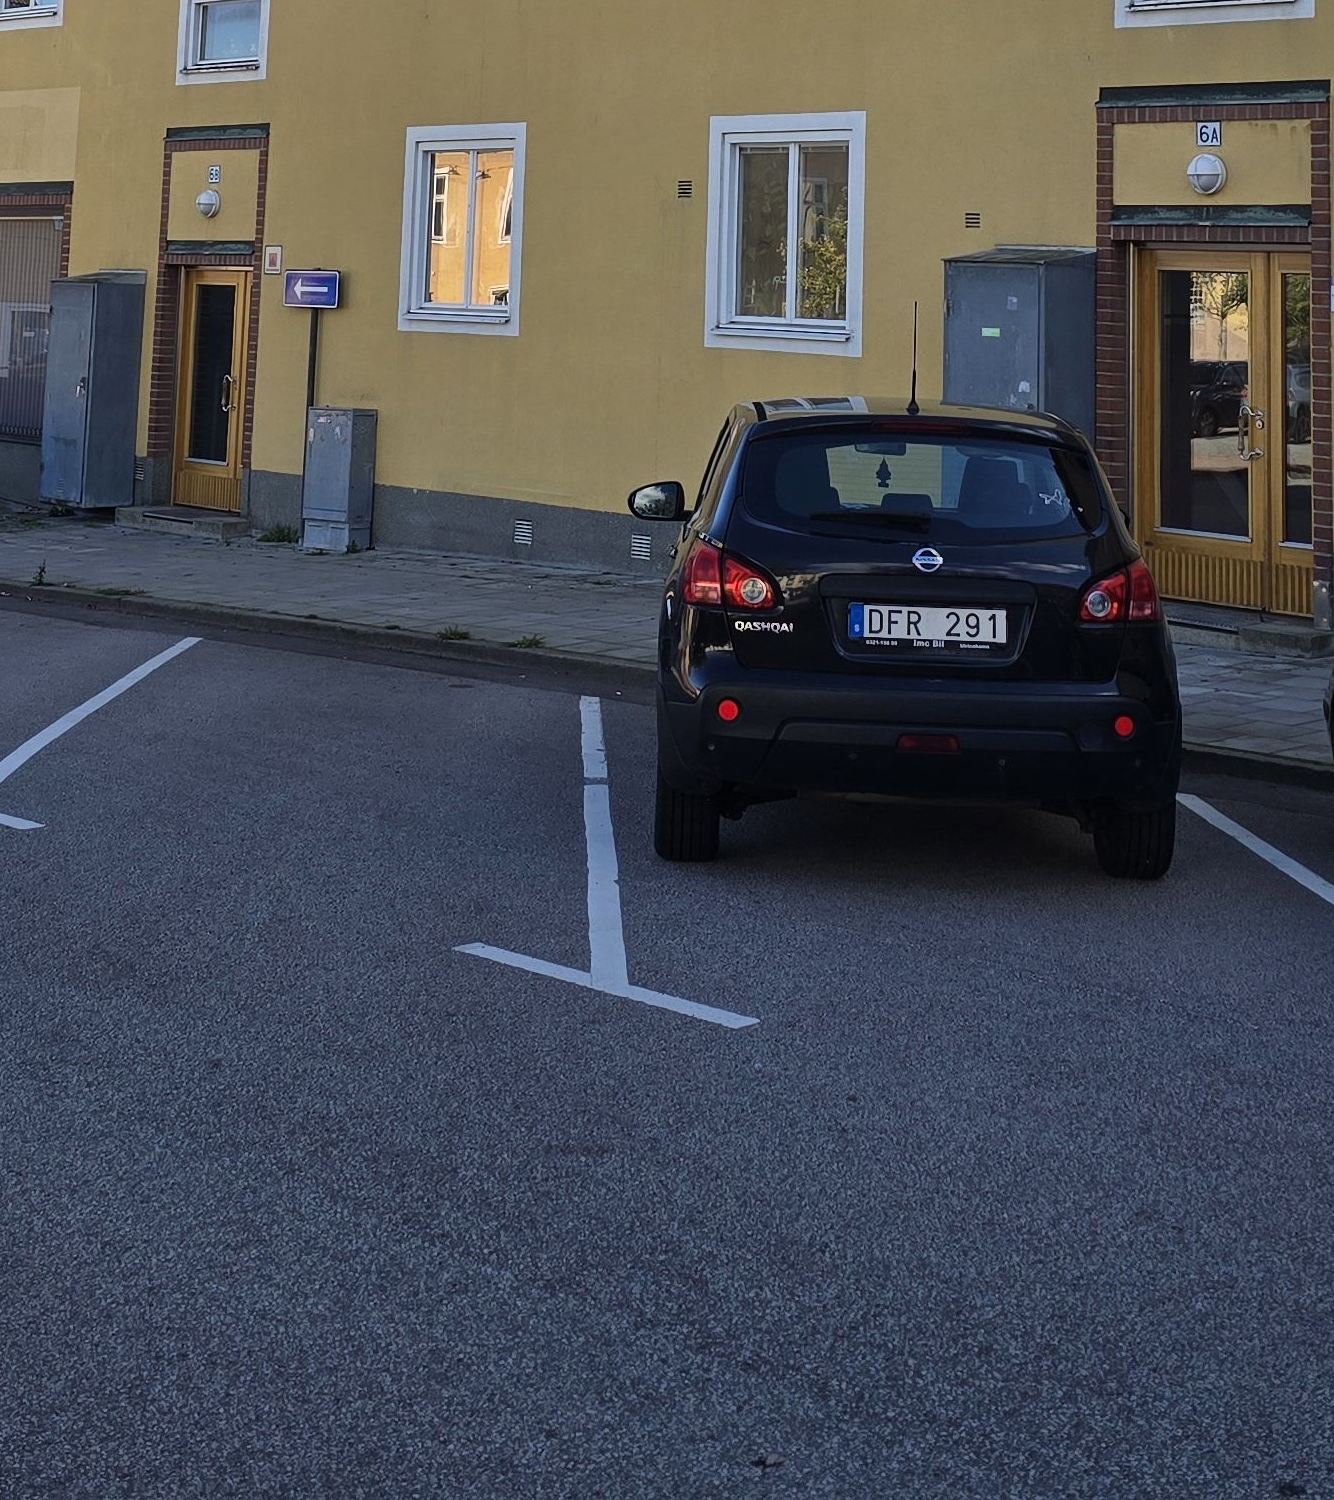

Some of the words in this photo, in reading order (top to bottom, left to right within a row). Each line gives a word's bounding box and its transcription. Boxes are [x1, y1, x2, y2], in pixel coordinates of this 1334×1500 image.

[1199, 124, 1219, 143] 6A
[734, 620, 794, 633] QASHQAI
[868, 608, 922, 637] DFR
[945, 611, 997, 639] 291
[932, 639, 945, 648] Bil
